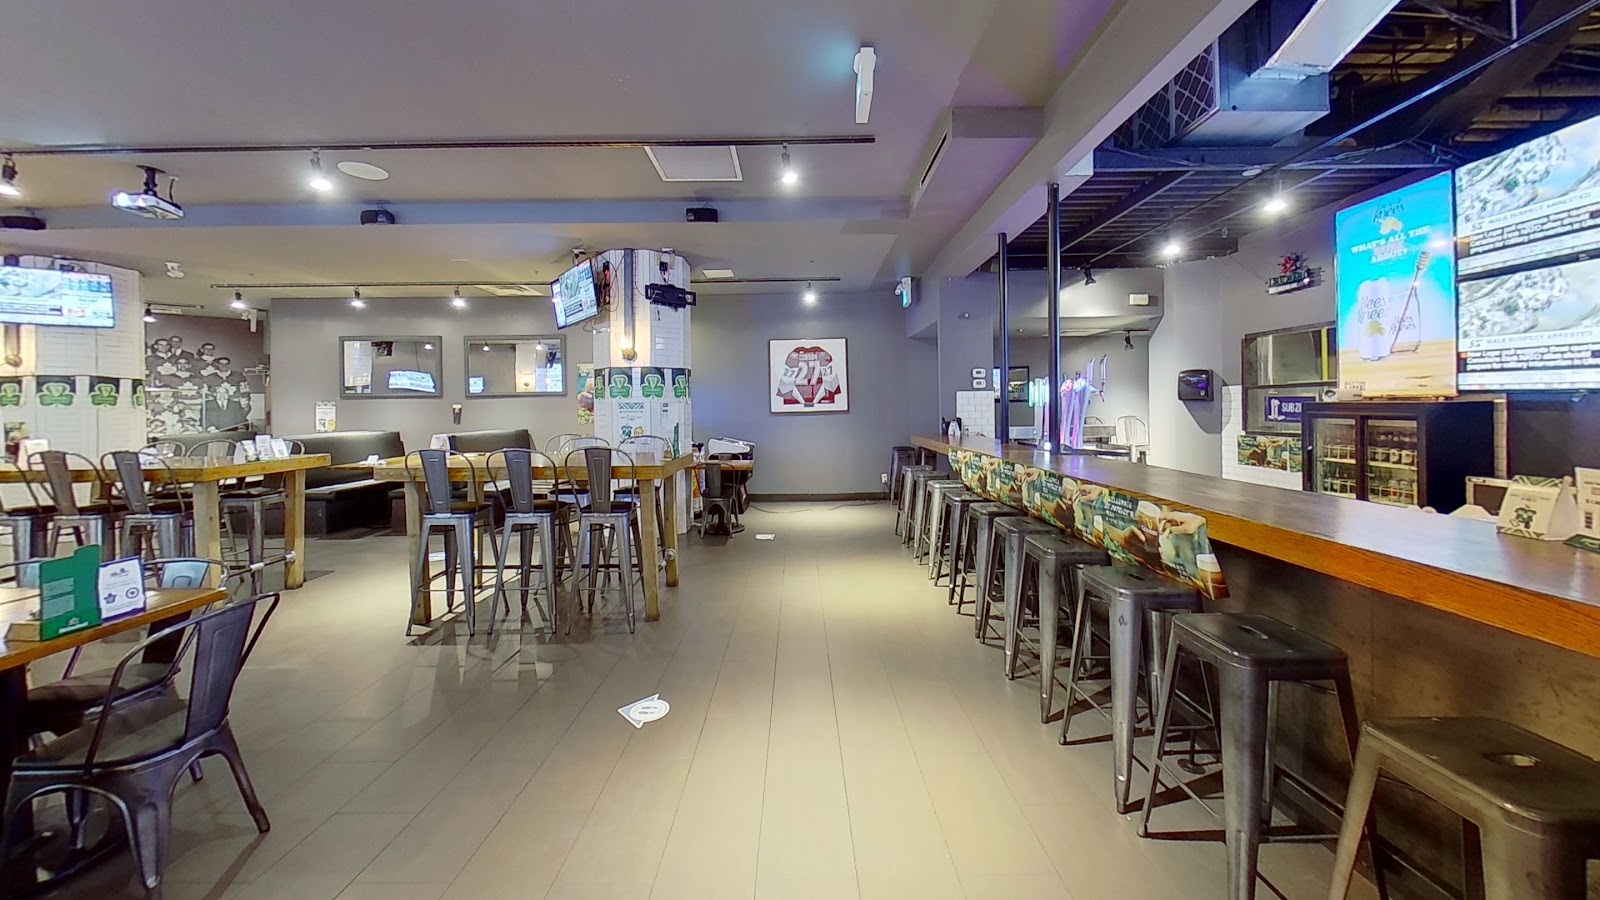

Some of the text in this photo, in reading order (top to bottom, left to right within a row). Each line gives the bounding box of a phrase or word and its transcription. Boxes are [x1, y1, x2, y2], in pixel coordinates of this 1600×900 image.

[1388, 232, 1407, 243] ALL
[1408, 225, 1432, 238] THE
[783, 368, 795, 378] 27
[794, 361, 821, 386] 27
